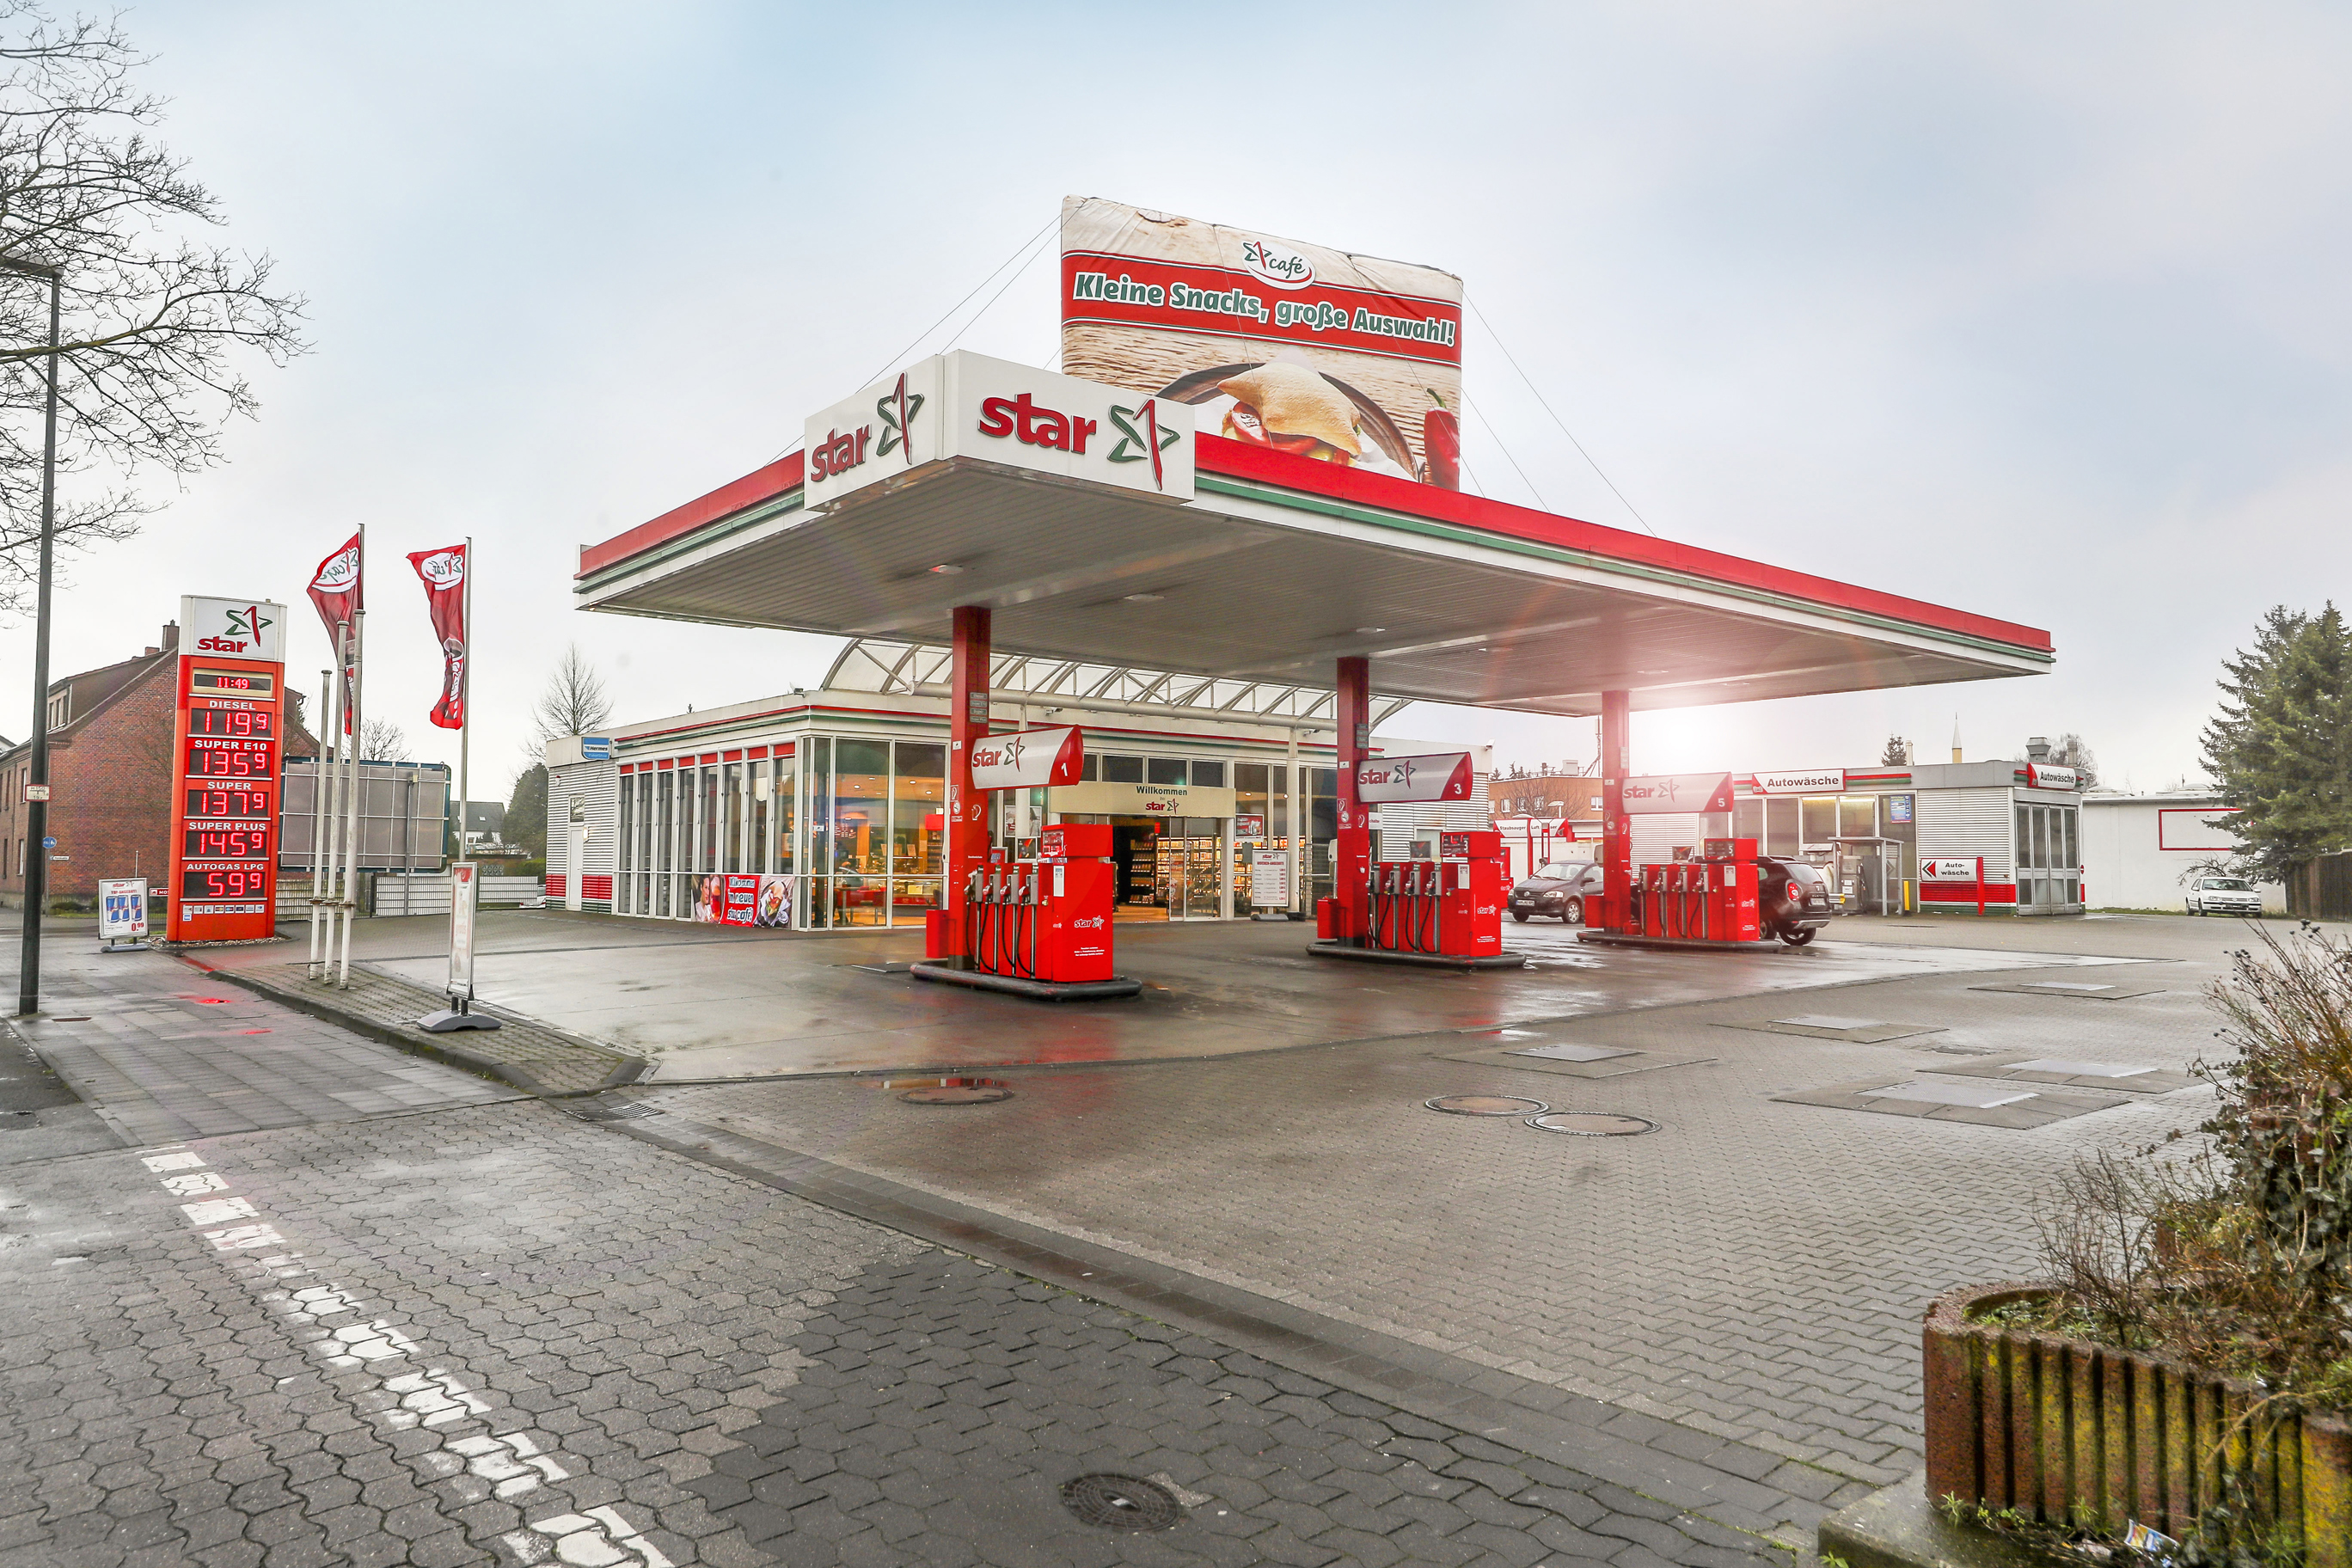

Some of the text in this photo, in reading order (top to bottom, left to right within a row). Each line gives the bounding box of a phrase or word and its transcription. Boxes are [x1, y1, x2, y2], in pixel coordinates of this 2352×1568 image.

[1269, 256, 1306, 279] café
[1075, 273, 1456, 346] Kleine Snacks, große Auswahl!
[977, 392, 1097, 455] star
[811, 423, 873, 482] star
[197, 635, 248, 653] star
[217, 676, 249, 689] 11:49
[209, 700, 256, 711] DIESEL
[194, 739, 267, 751] SUPER E10
[972, 747, 1002, 768] star
[1061, 763, 1069, 777] 1
[1358, 769, 1391, 785] star
[1767, 776, 1840, 787] Autowäsche
[2040, 771, 2074, 783] Autowäsche
[207, 781, 252, 790] SUPER
[1136, 786, 1188, 795] Willkommen
[1454, 783, 1462, 794] 3
[1623, 785, 1655, 799] star
[1145, 801, 1166, 811] star
[1718, 798, 1725, 807] 5
[189, 822, 266, 831] SUPER PLUS
[131, 922, 144, 932] 0.99
[1074, 918, 1092, 928] star
